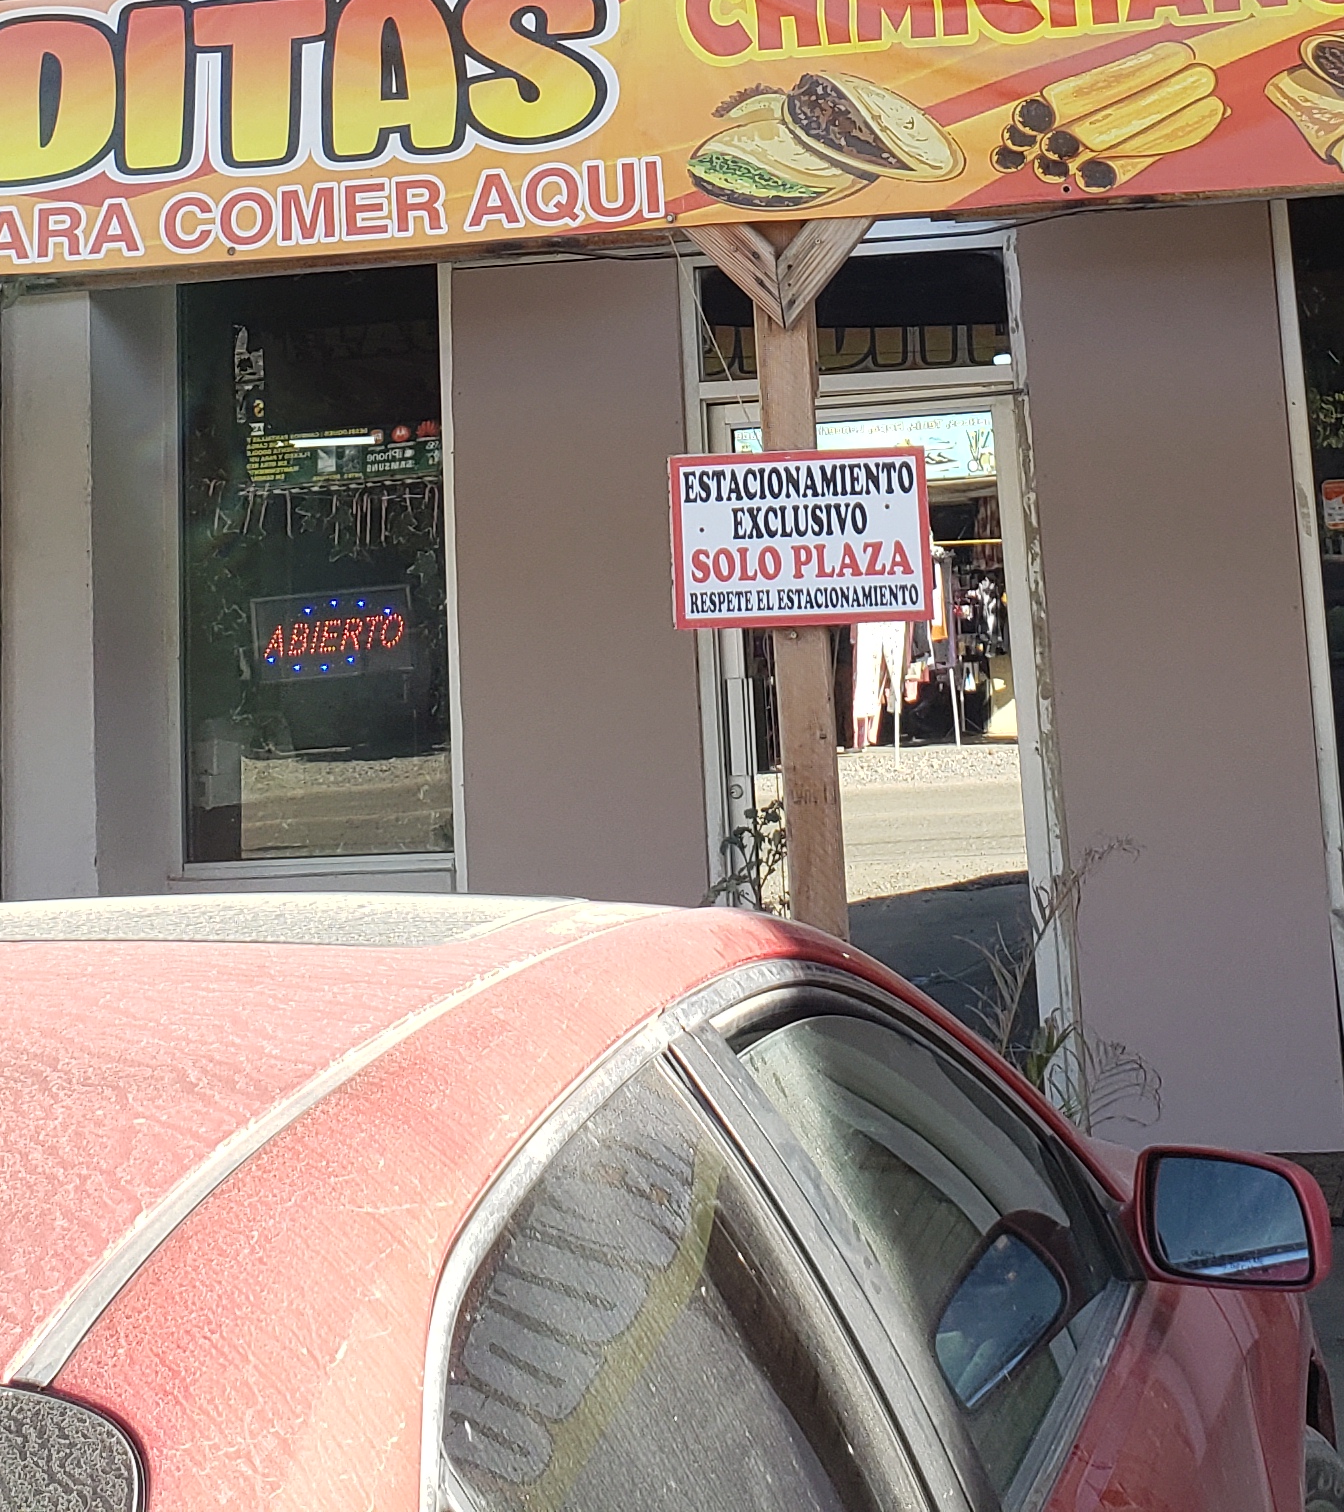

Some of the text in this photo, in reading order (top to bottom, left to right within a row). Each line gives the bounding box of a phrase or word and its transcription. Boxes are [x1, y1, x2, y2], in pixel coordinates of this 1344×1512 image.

[162, 170, 446, 253] COMER
[464, 155, 666, 233] AQUI
[683, 461, 914, 503] ESTACIONAMIENTO
[731, 501, 868, 540] EXCLUSIVO
[691, 539, 914, 583] SOLO PLAZA
[690, 583, 919, 614] RESPETE EL ESTACIONAMIENTO
[263, 612, 405, 659] ABIERTO
